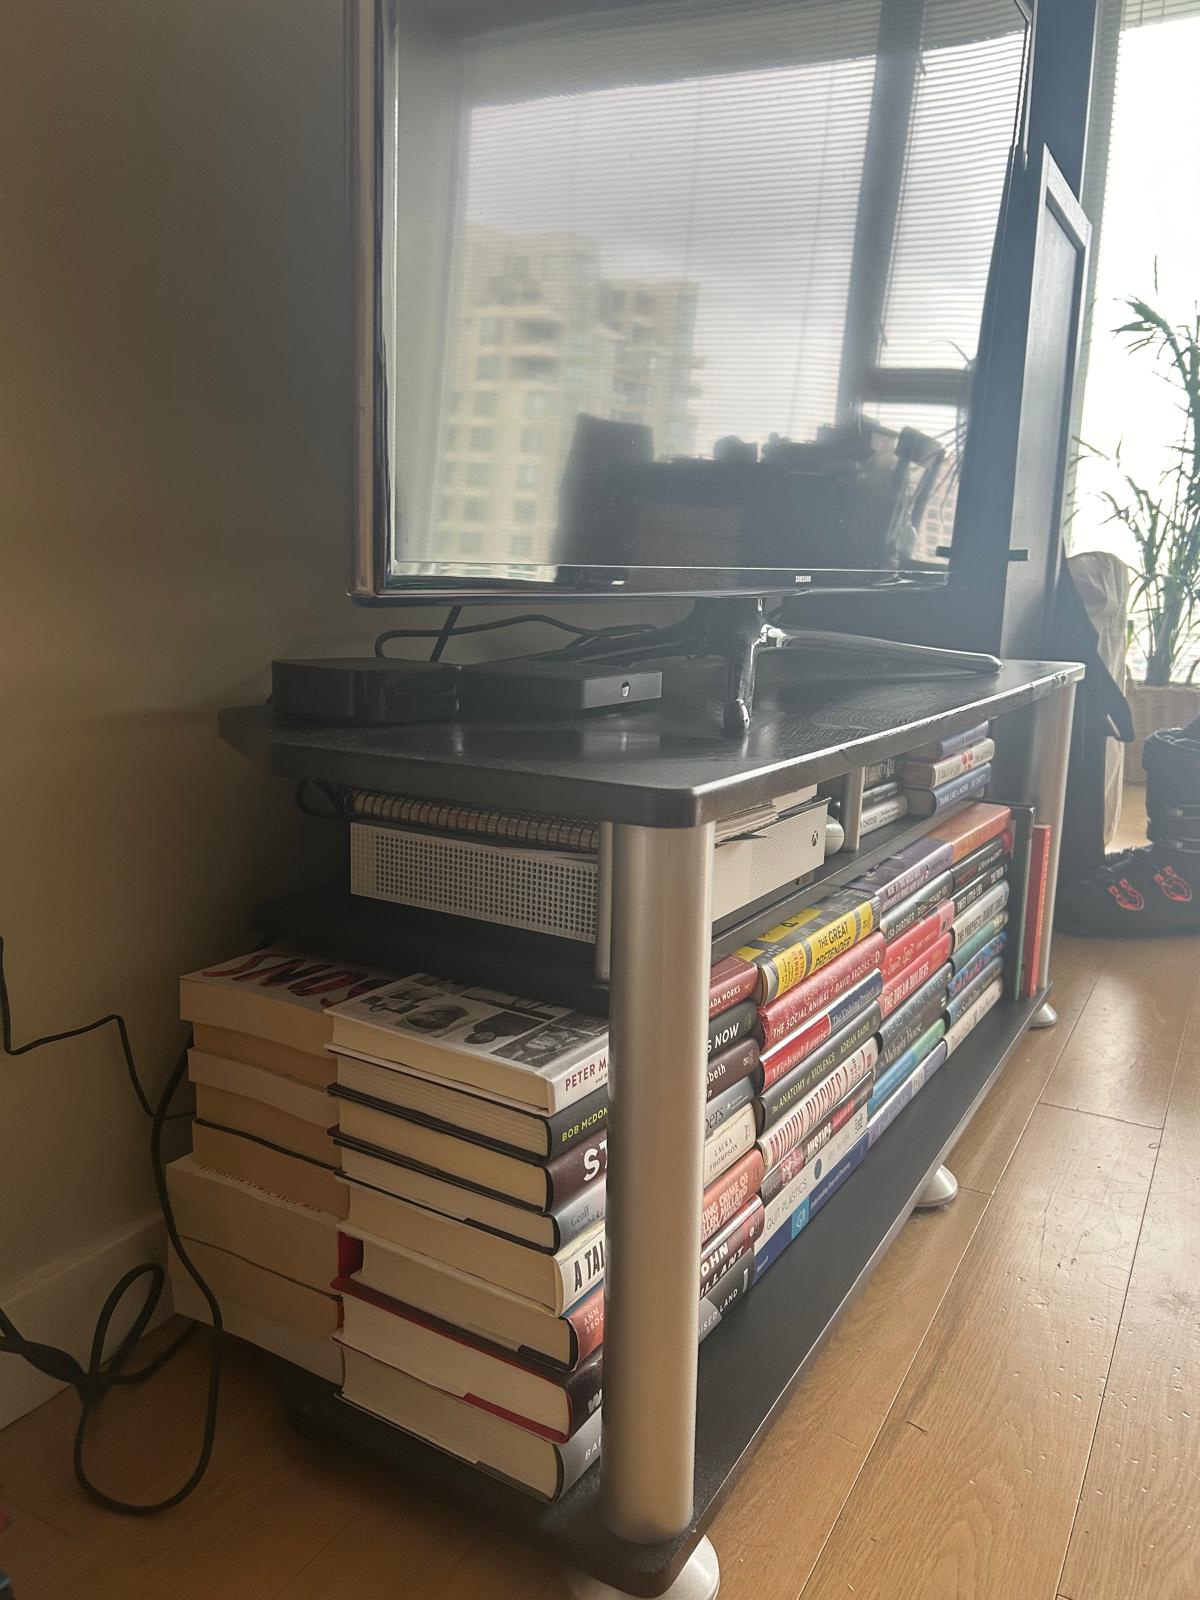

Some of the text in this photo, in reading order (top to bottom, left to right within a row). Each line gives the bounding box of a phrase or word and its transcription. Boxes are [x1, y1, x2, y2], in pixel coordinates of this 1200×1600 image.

[817, 920, 849, 949] THE GREAT
[815, 936, 852, 968] PRETENDER
[722, 985, 741, 1001] WORKS
[773, 961, 871, 1038] THE SOCIAL ANIMAL DAVID BROOKS
[884, 991, 894, 1014] THE
[886, 1014, 904, 1038] DEAD
[914, 994, 927, 1010] THE
[714, 1022, 740, 1050] NOW
[565, 1063, 596, 1093] PETER
[772, 1053, 800, 1081] Michael
[779, 1078, 805, 1110] ANATOMY
[811, 1051, 836, 1081] VIOLENCE
[840, 1033, 857, 1055] ADRIAN
[856, 1020, 870, 1041] RAINE
[561, 1124, 580, 1143] BOB
[714, 1136, 733, 1158] LAURA
[709, 1143, 738, 1173] THOMPSON
[719, 1180, 740, 1206] CRIME
[740, 1171, 749, 1186] OF
[570, 1203, 590, 1228] Geoff
[766, 1178, 808, 1231] QUIT PLASTICS
[700, 1240, 729, 1278] OHN
[573, 1259, 583, 1293] A
[719, 1287, 739, 1313] LAND
[583, 1307, 600, 1327] ANN
